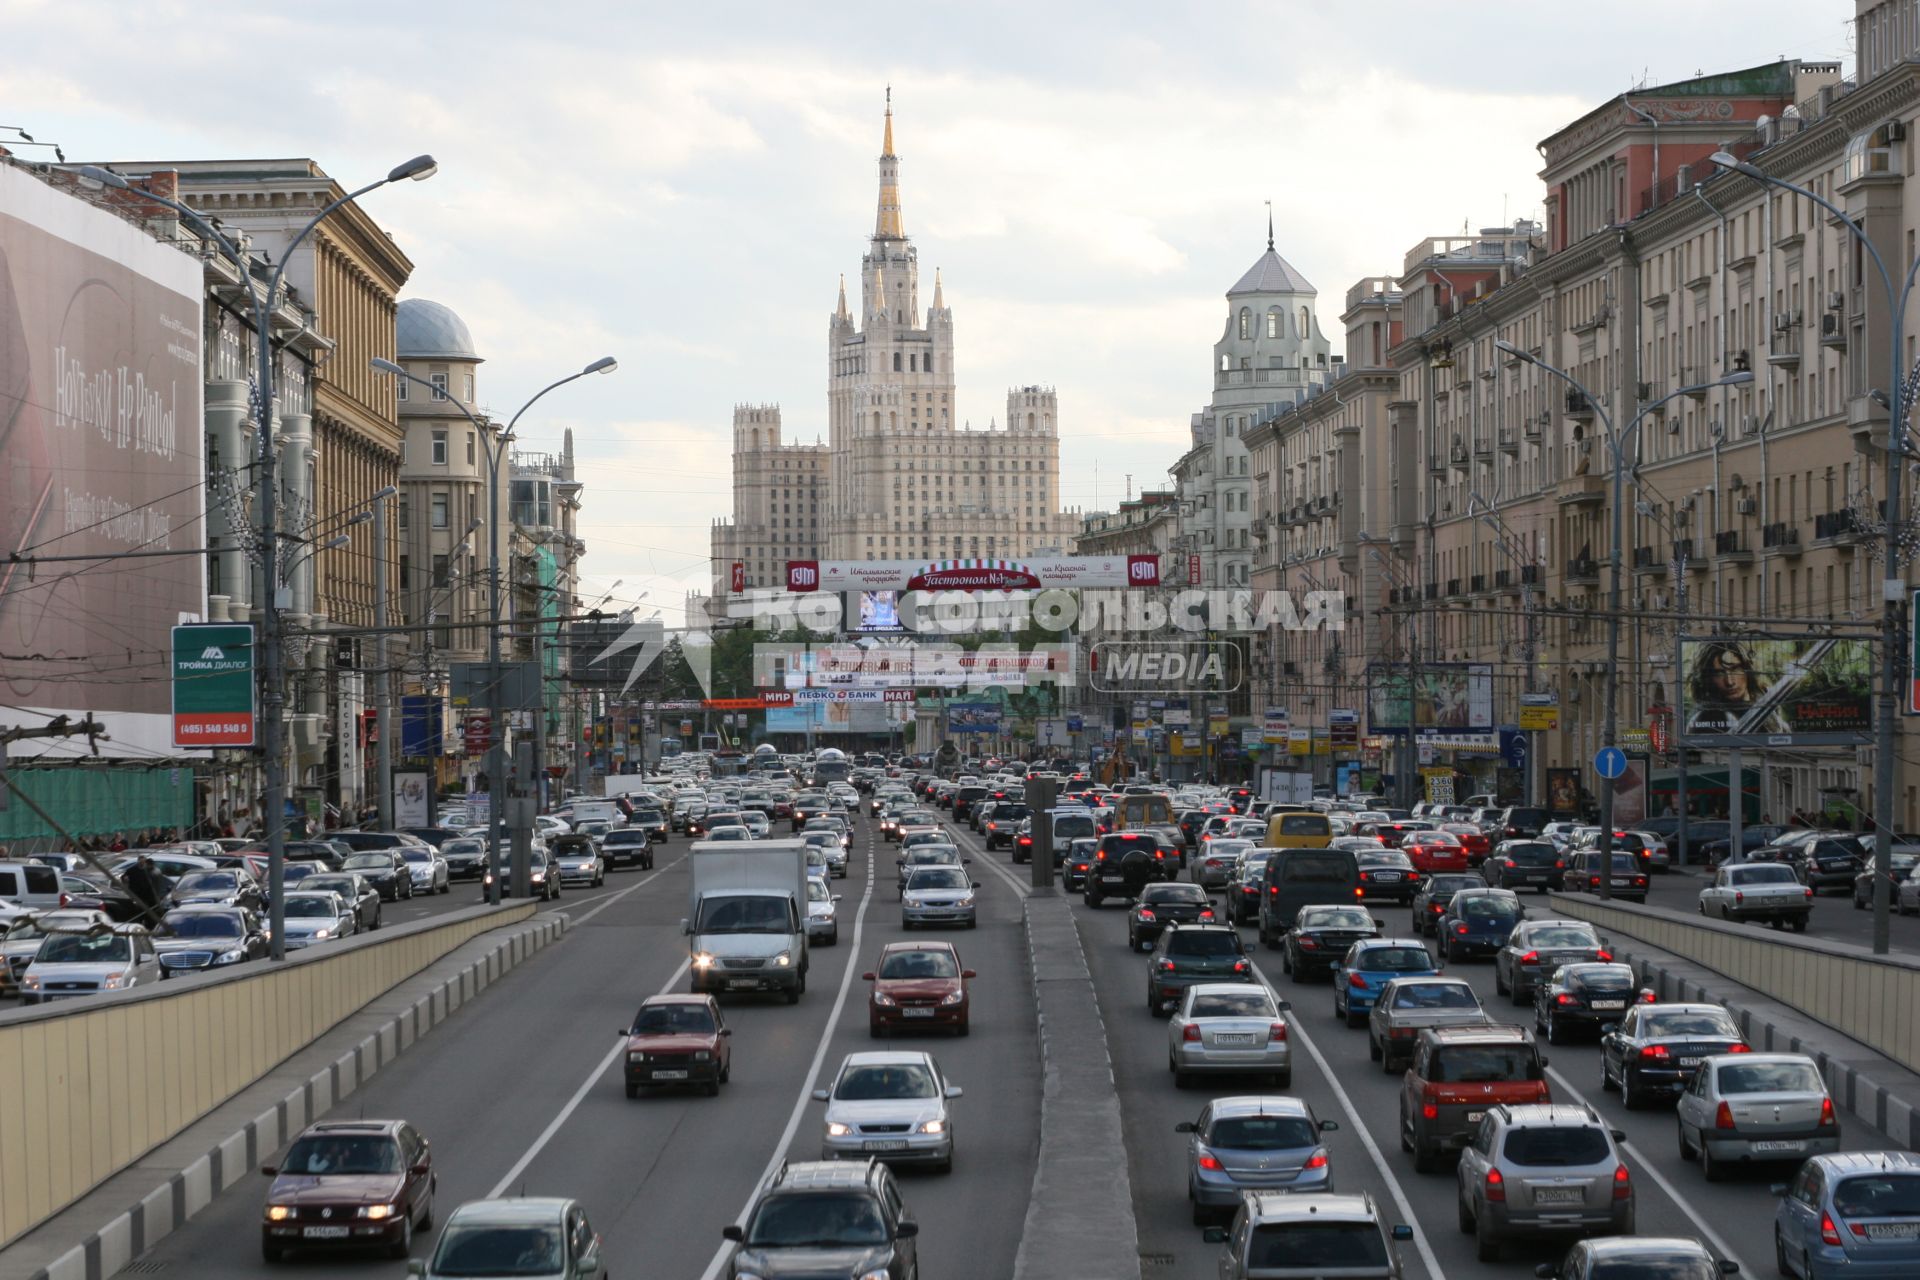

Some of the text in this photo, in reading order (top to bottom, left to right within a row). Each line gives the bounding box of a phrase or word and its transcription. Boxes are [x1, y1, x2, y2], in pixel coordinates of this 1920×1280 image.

[1054, 563, 1087, 573] Красной
[924, 573, 987, 587] Гастроном
[178, 660, 248, 670] ТРОЙКА ДИАЛОГ
[765, 692, 791, 702] МИР
[848, 691, 877, 699] БАНК
[885, 690, 911, 701] МАЙ
[181, 723, 203, 735] (495)
